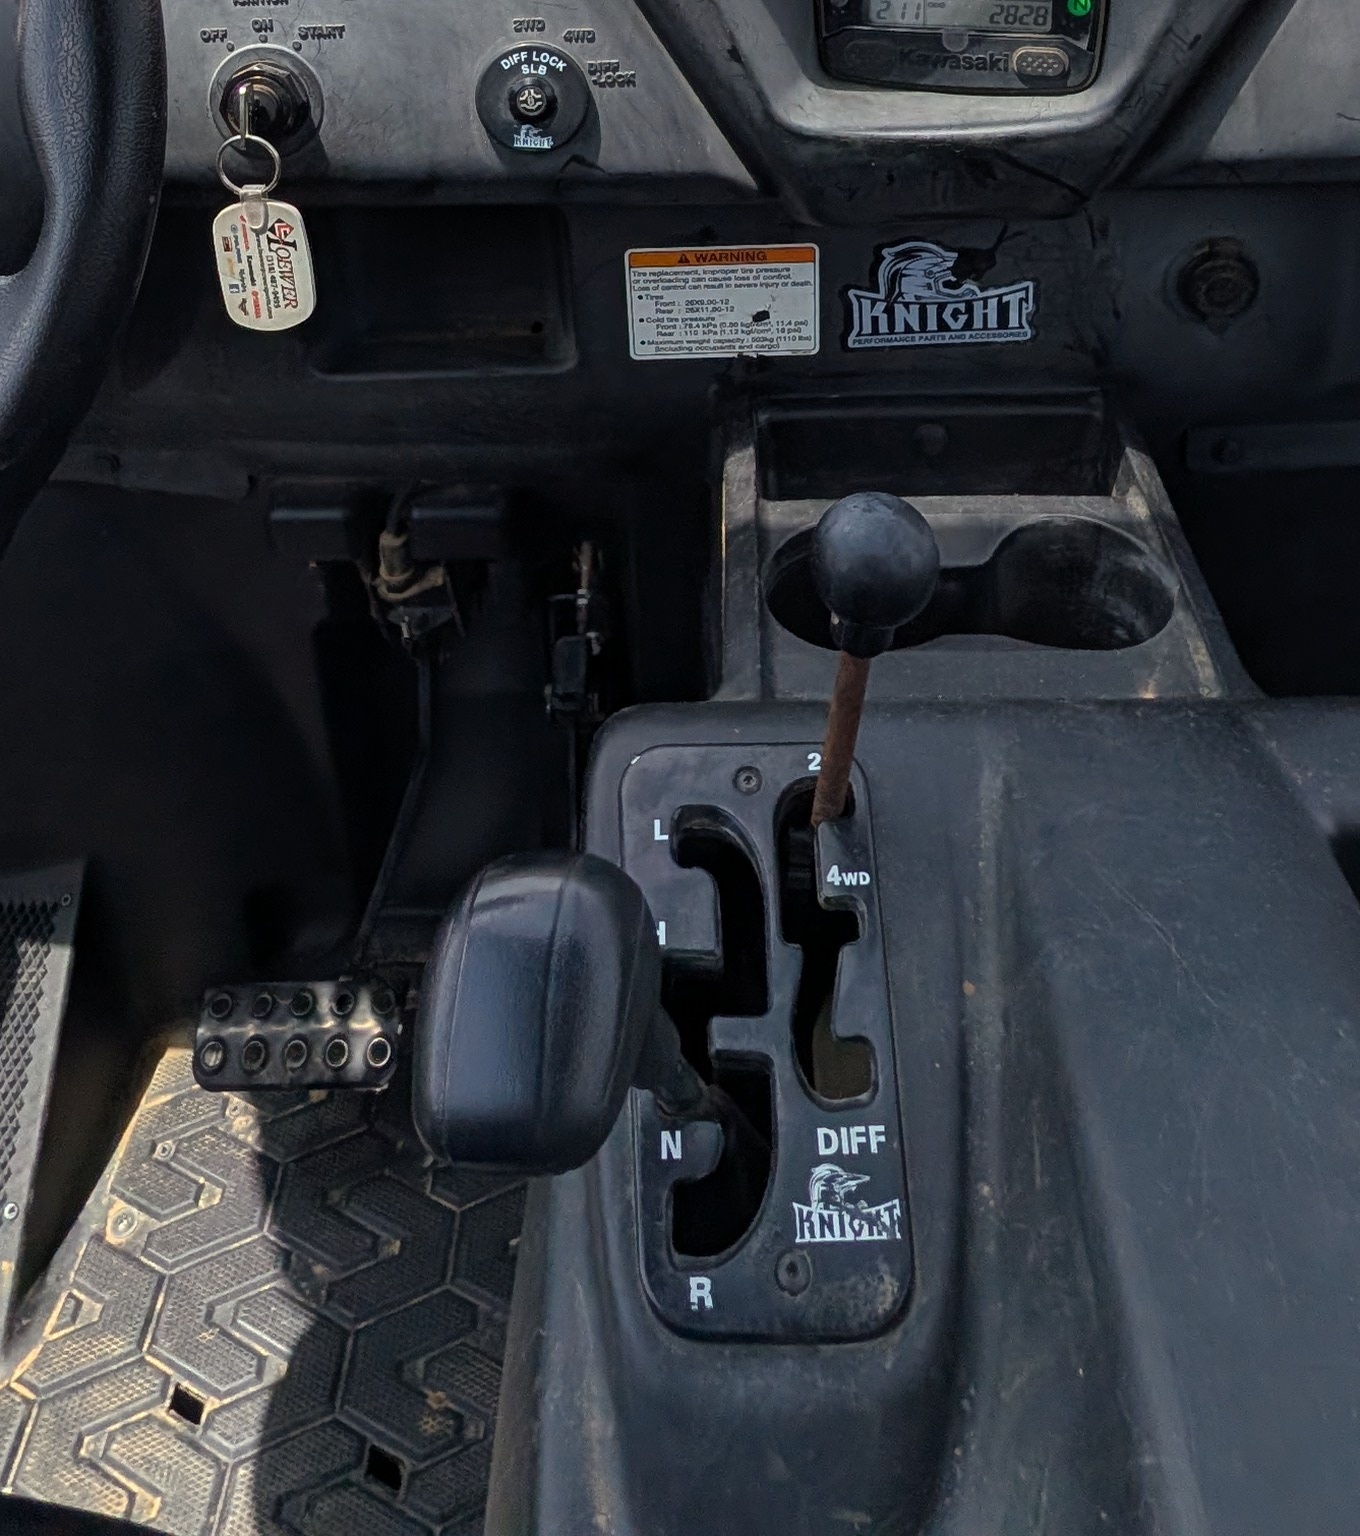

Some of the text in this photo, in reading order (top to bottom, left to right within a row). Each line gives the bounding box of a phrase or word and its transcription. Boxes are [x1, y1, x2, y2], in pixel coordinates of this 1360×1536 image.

[251, 18, 274, 33] ON
[297, 24, 345, 40] START
[512, 17, 546, 33] 2WD
[200, 28, 228, 43] OFF
[563, 28, 596, 44] 4WD
[500, 51, 567, 72] DIFF LOCK
[587, 60, 620, 75] DIFF
[896, 48, 1009, 72] Kawasaki
[521, 64, 547, 75] SLB
[514, 135, 554, 148] KNIGHT
[694, 250, 767, 262] WARNING
[860, 290, 1027, 334] KNIGHT
[852, 335, 916, 346] PERFORMANCE
[948, 333, 966, 341] AND
[653, 819, 669, 841] L
[826, 864, 871, 887] 4WD
[660, 1130, 682, 1160] N
[816, 1124, 887, 1156] DIFF
[689, 1276, 714, 1310] R
